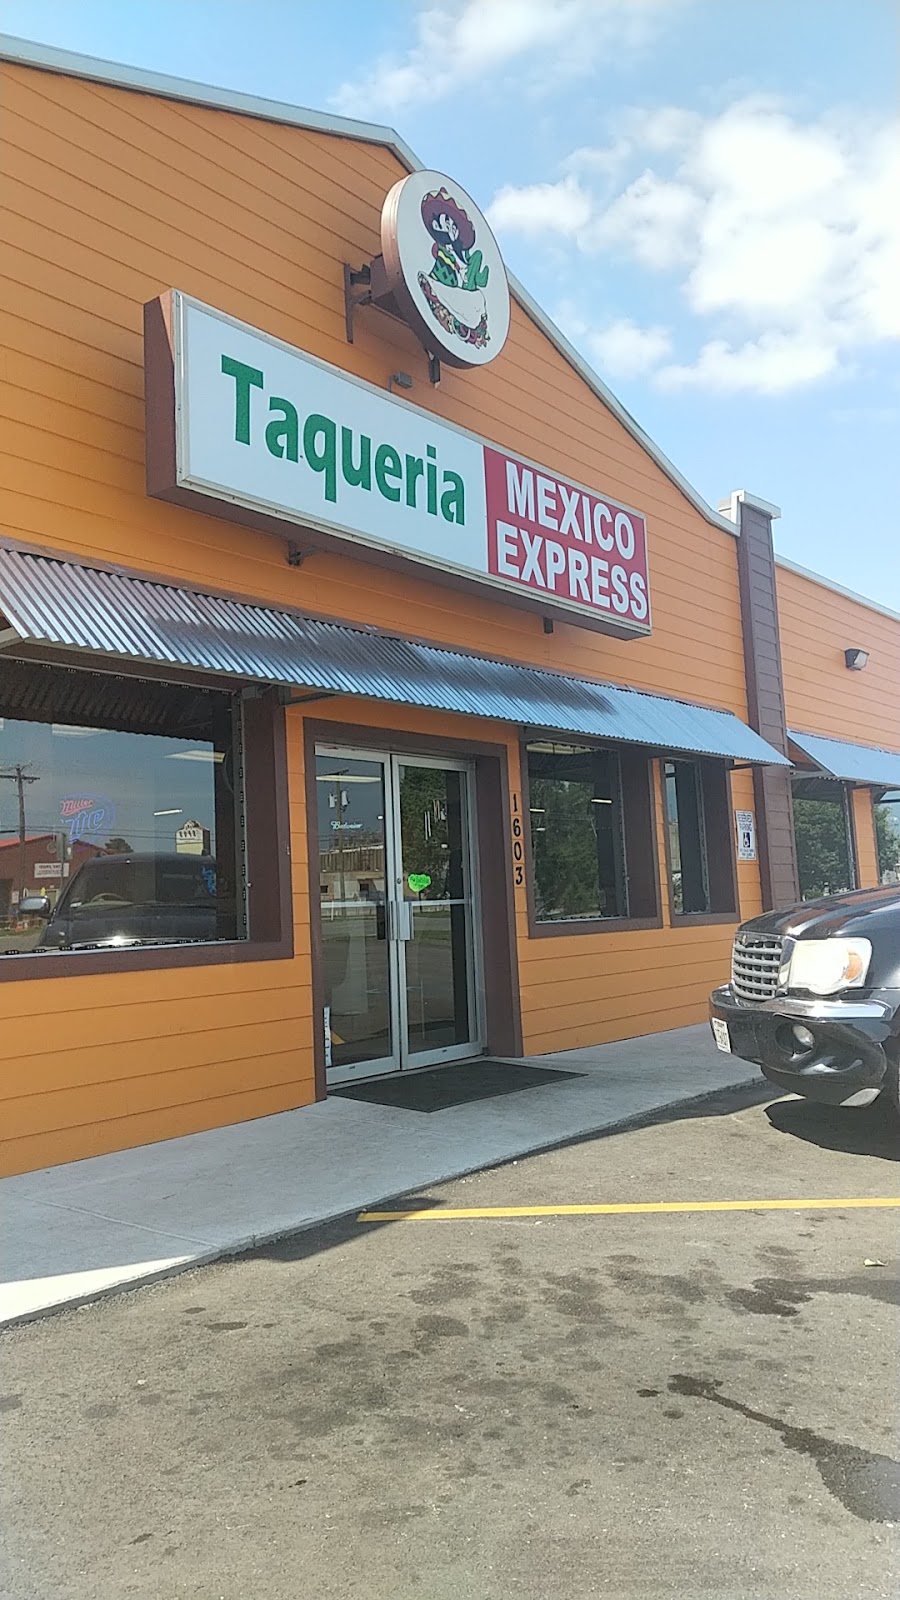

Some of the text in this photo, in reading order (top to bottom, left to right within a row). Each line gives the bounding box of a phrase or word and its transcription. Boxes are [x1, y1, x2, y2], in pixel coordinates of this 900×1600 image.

[221, 354, 466, 526] Taqueria
[505, 459, 636, 560] MEXICO
[496, 519, 648, 620] EXPRESS
[512, 793, 523, 885] 1603
